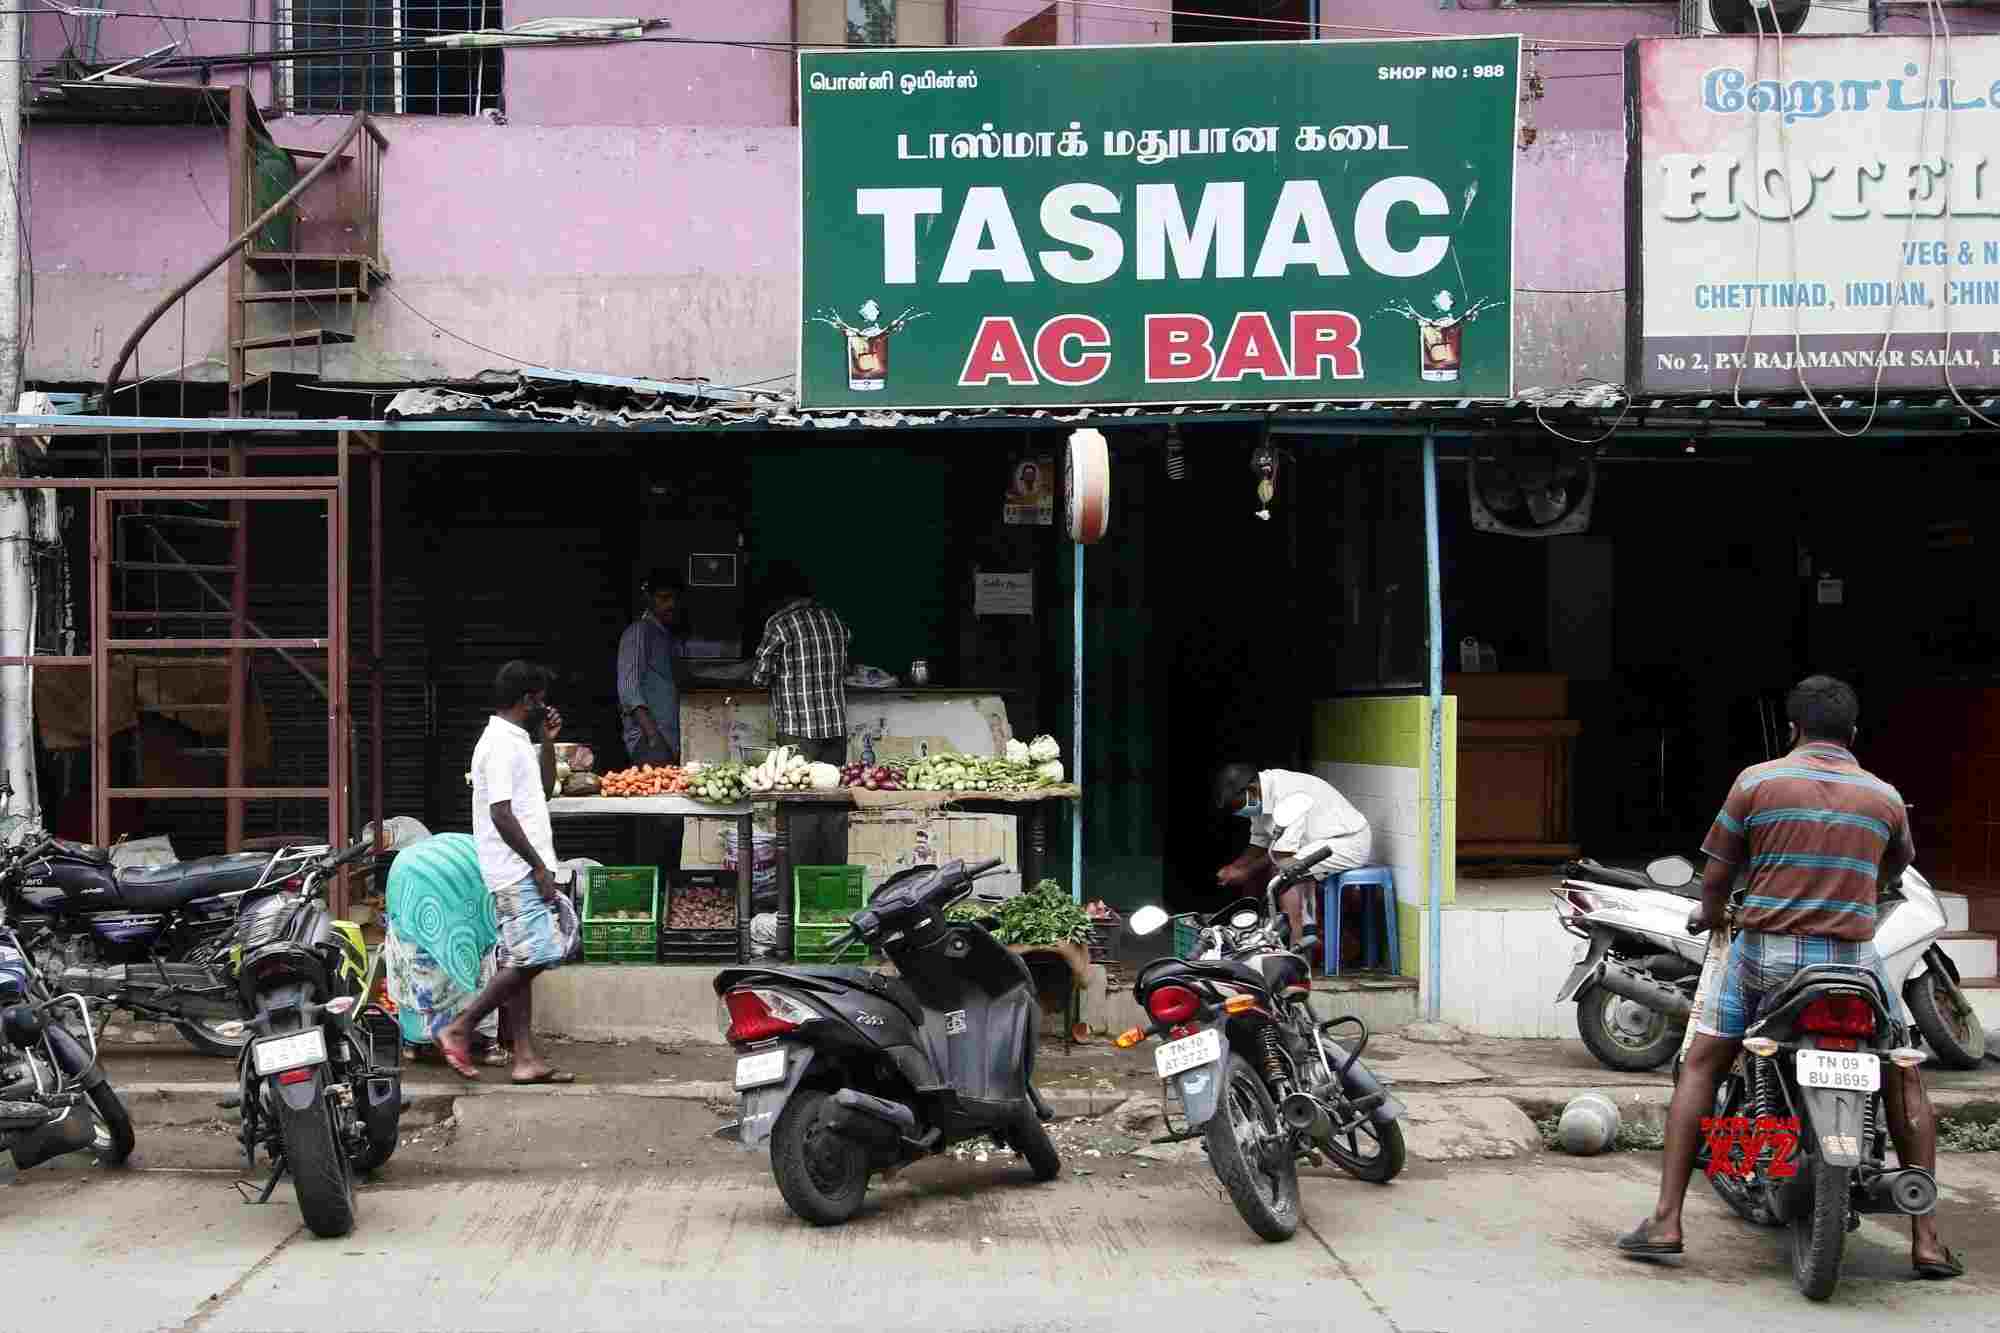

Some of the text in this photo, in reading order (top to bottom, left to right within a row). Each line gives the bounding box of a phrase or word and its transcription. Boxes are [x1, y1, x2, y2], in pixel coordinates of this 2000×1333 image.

[810, 70, 977, 95] பொன்னி ஒயின்ஸ்
[1378, 66, 1427, 80] SHOP
[1432, 65, 1457, 79] NO
[1473, 65, 1504, 78] 988
[897, 121, 1408, 164] டாஸ்மாக் மதுபான கடை
[1660, 155, 2000, 222] HOTEL
[856, 176, 1450, 284] TASMAC
[1903, 241, 1947, 265] VEG
[1958, 241, 1973, 264] &
[1695, 284, 1834, 309] CHETTINAD,
[1846, 281, 1934, 307] INDIAN,
[958, 310, 1364, 386] AC BAR
[1657, 354, 1685, 370] No
[1690, 353, 1709, 374] 2,
[1753, 350, 1904, 369] RAJAMANNAR
[1817, 1056, 1859, 1070] TN 09
[1808, 1072, 1870, 1088] BU 8695
